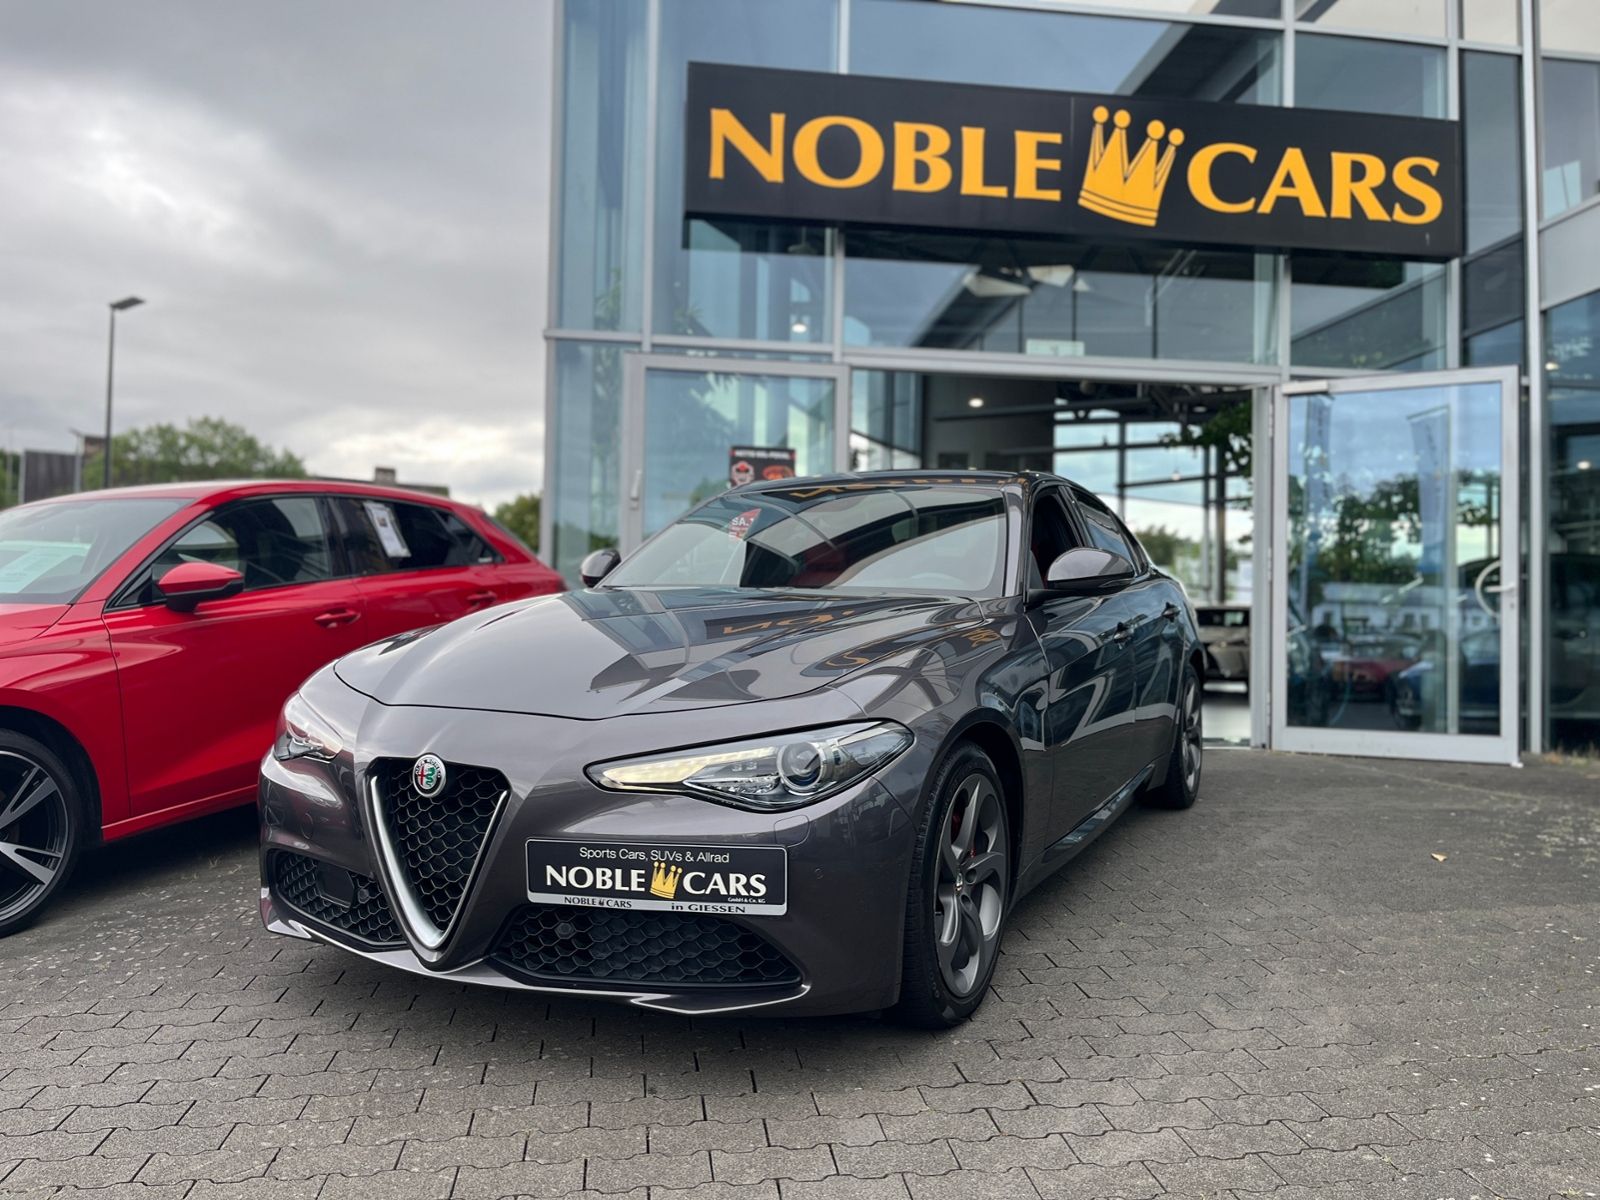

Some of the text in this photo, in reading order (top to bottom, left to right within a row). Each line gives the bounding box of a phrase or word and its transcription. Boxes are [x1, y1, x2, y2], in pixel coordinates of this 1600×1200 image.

[709, 108, 1443, 225] NOBLE CARS
[580, 847, 729, 863] Sports Cars, SUVs & Allrad
[546, 865, 767, 897] NOBLE CARS
[564, 897, 632, 908] NOBLE CARS
[671, 903, 746, 913] in GIESSEN
